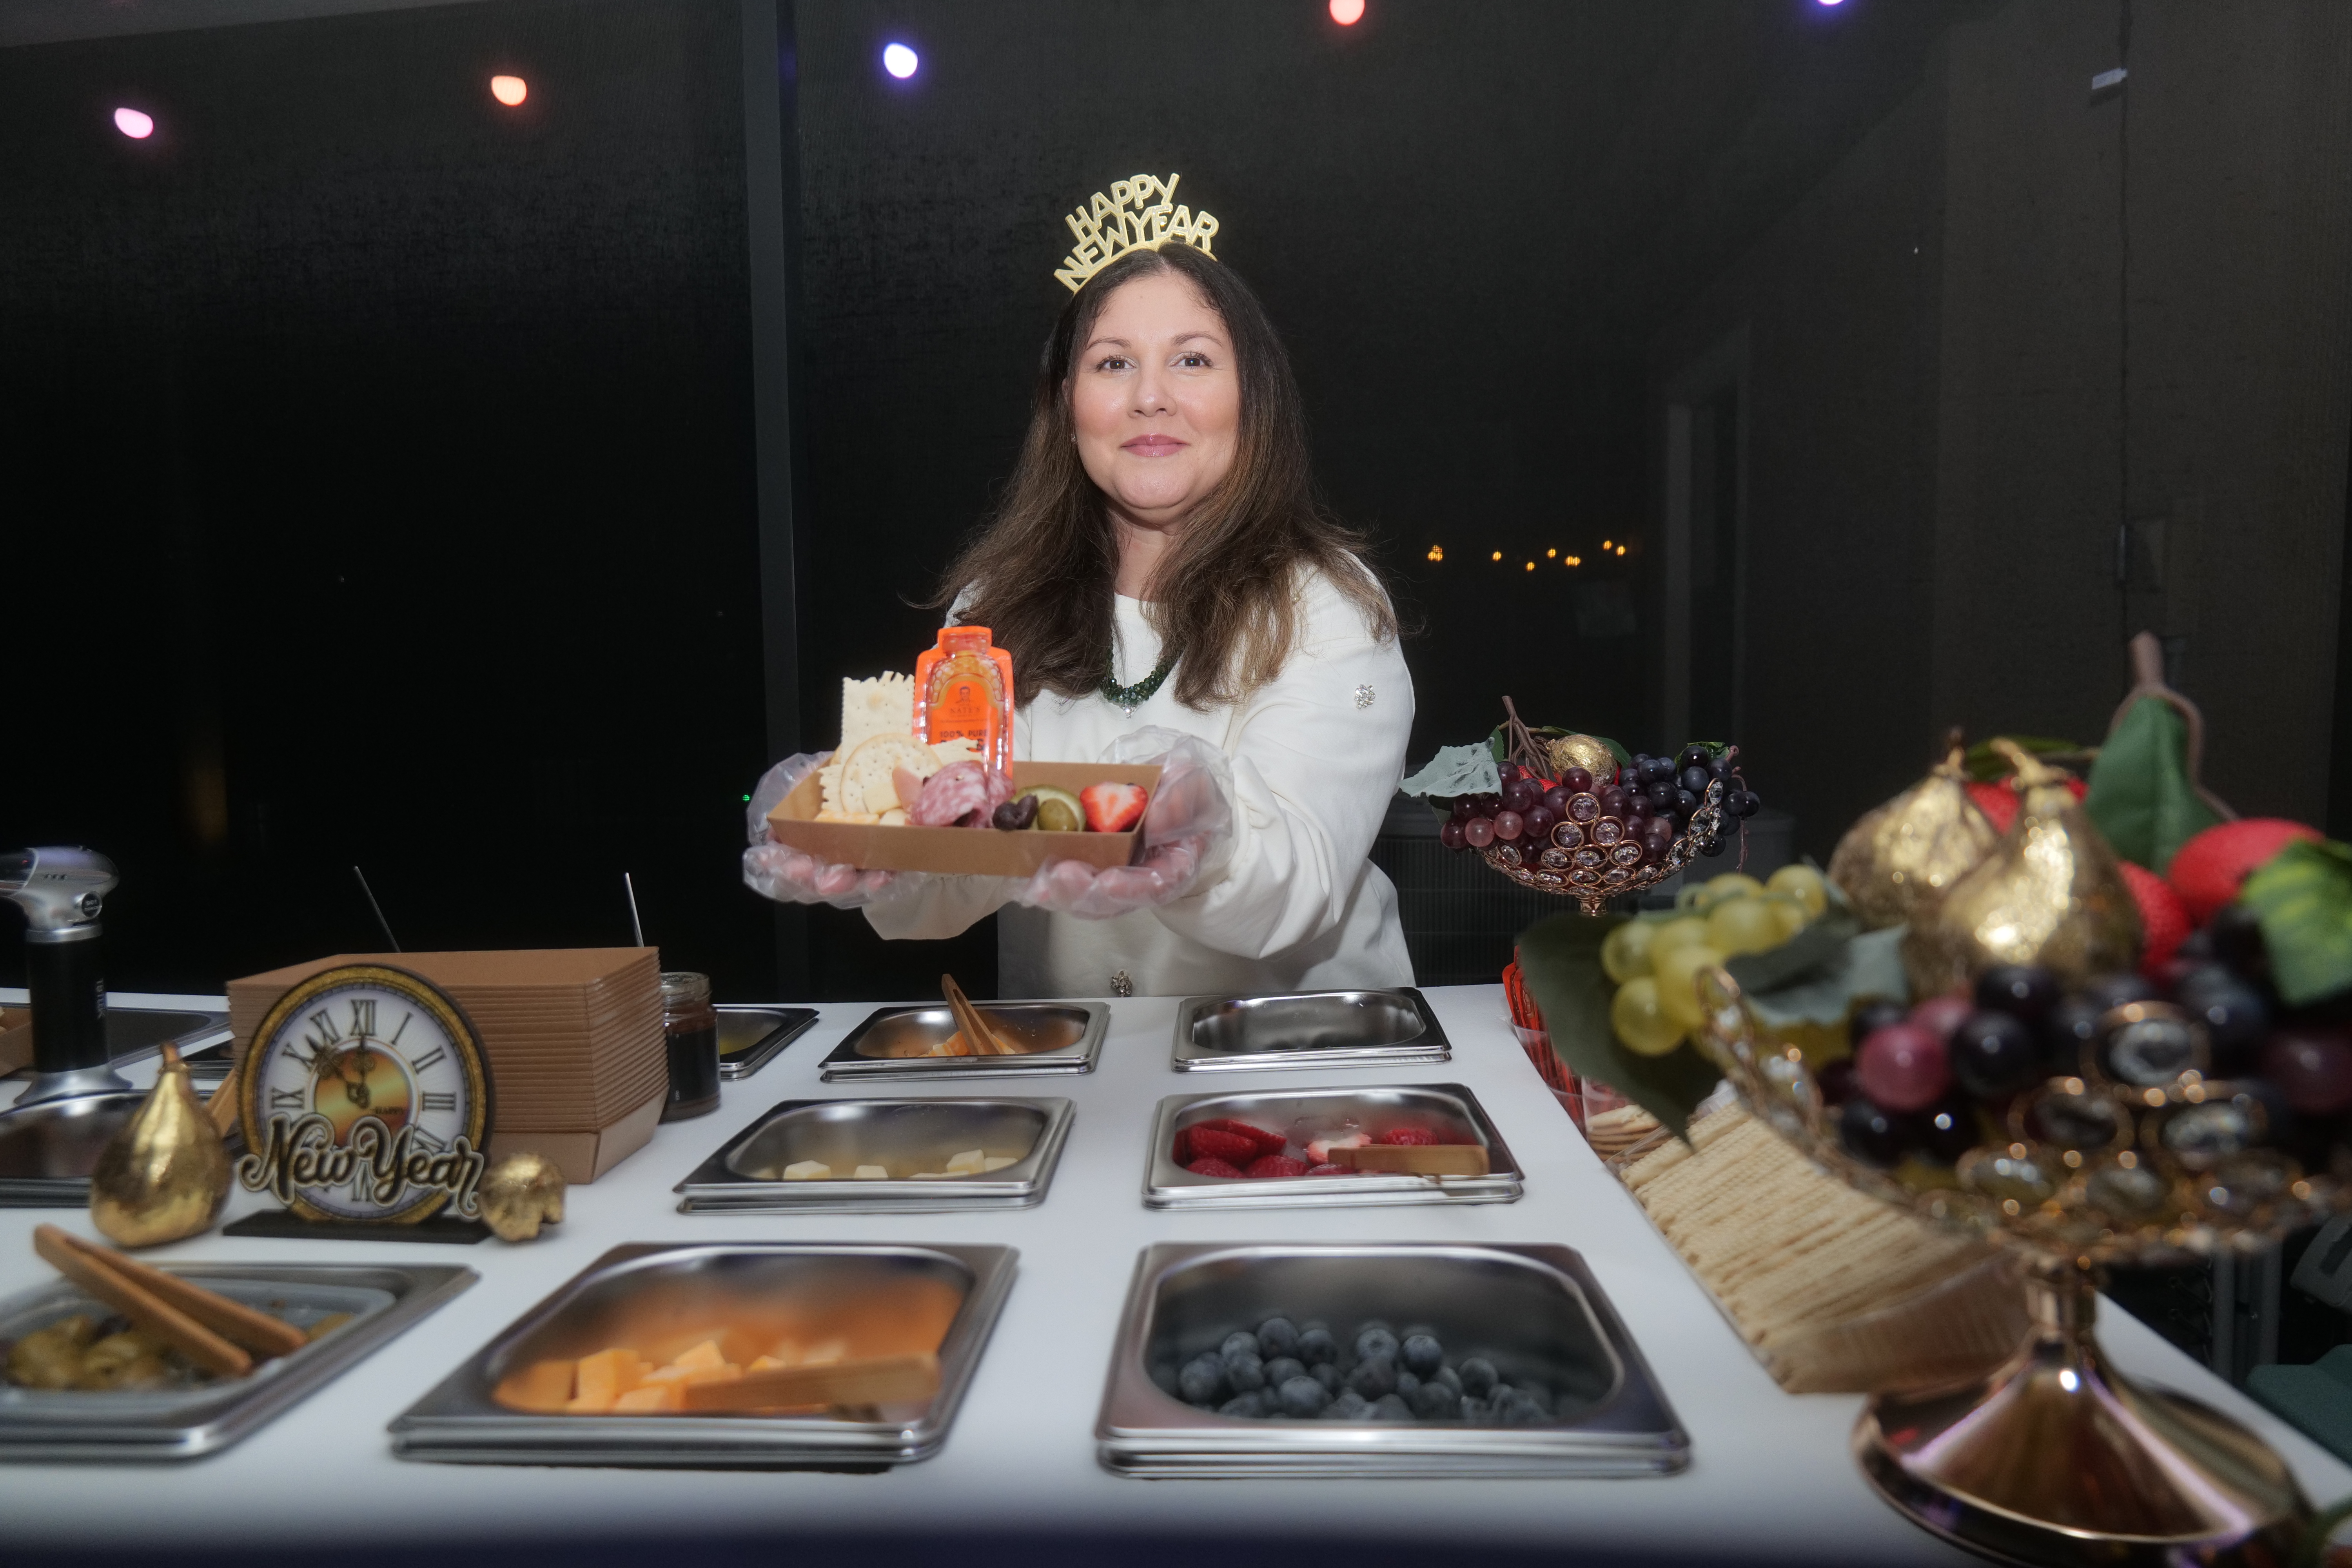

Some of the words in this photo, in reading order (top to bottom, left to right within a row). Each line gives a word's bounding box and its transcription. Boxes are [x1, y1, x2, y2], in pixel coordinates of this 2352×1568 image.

[1065, 173, 1180, 243] HAPPY
[239, 1112, 354, 1205] New
[350, 1116, 484, 1220] Year
